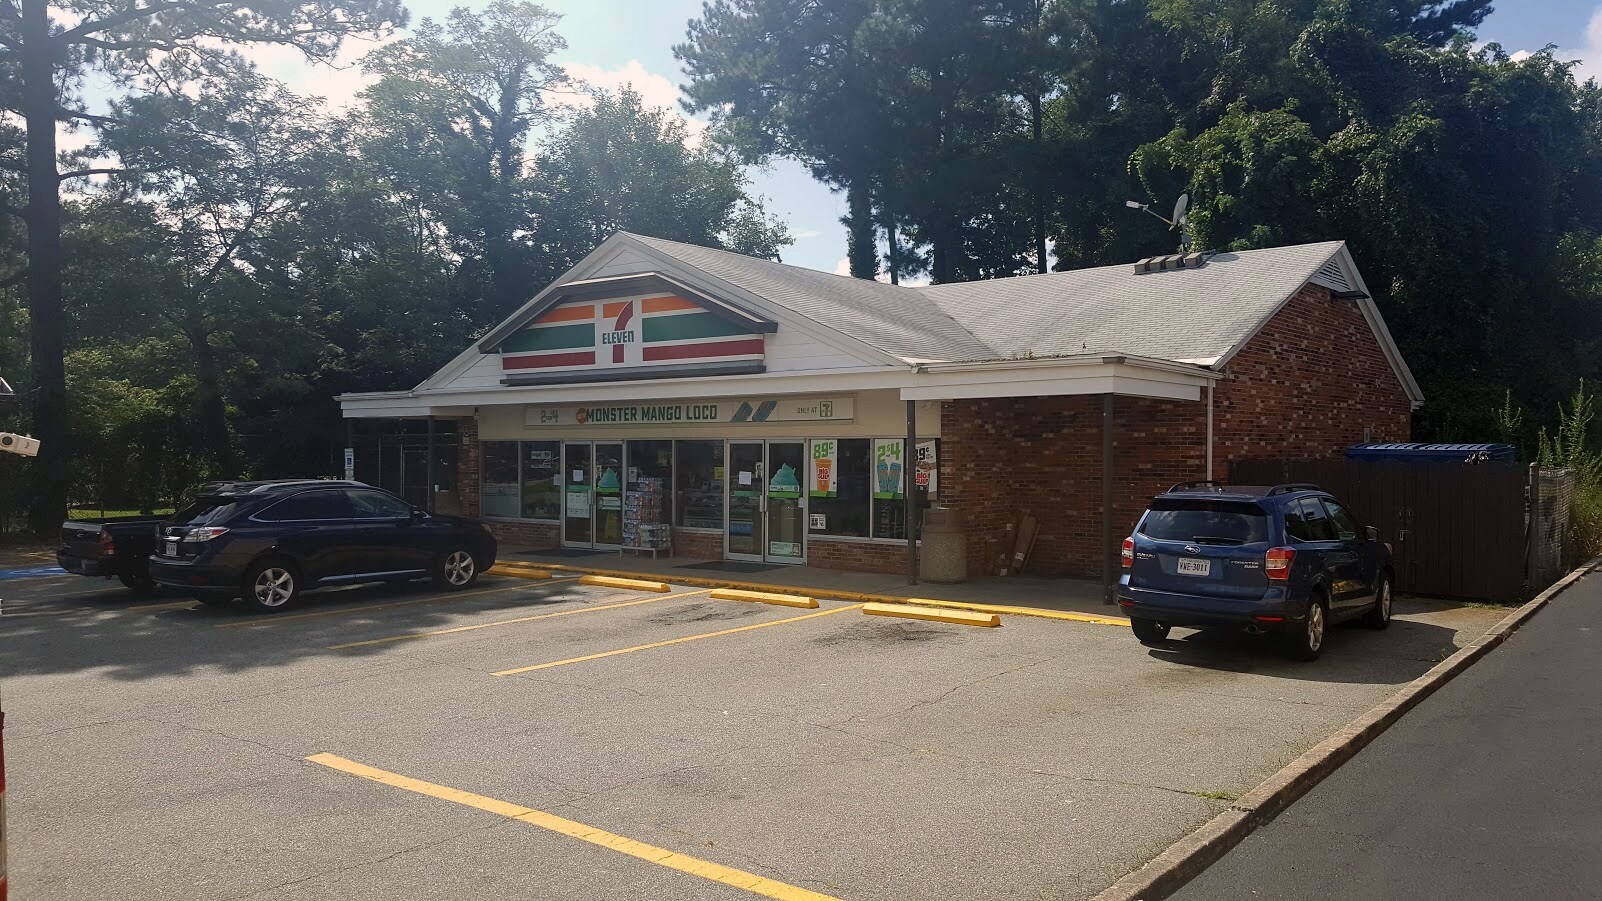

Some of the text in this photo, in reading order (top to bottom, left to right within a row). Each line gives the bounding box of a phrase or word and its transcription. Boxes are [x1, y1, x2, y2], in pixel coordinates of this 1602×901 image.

[586, 407, 638, 423] MONSTER
[641, 405, 682, 421] MANGO
[686, 404, 718, 420] LOCO
[811, 406, 818, 414] AT
[818, 467, 829, 475] BIG
[916, 471, 928, 479] BIG
